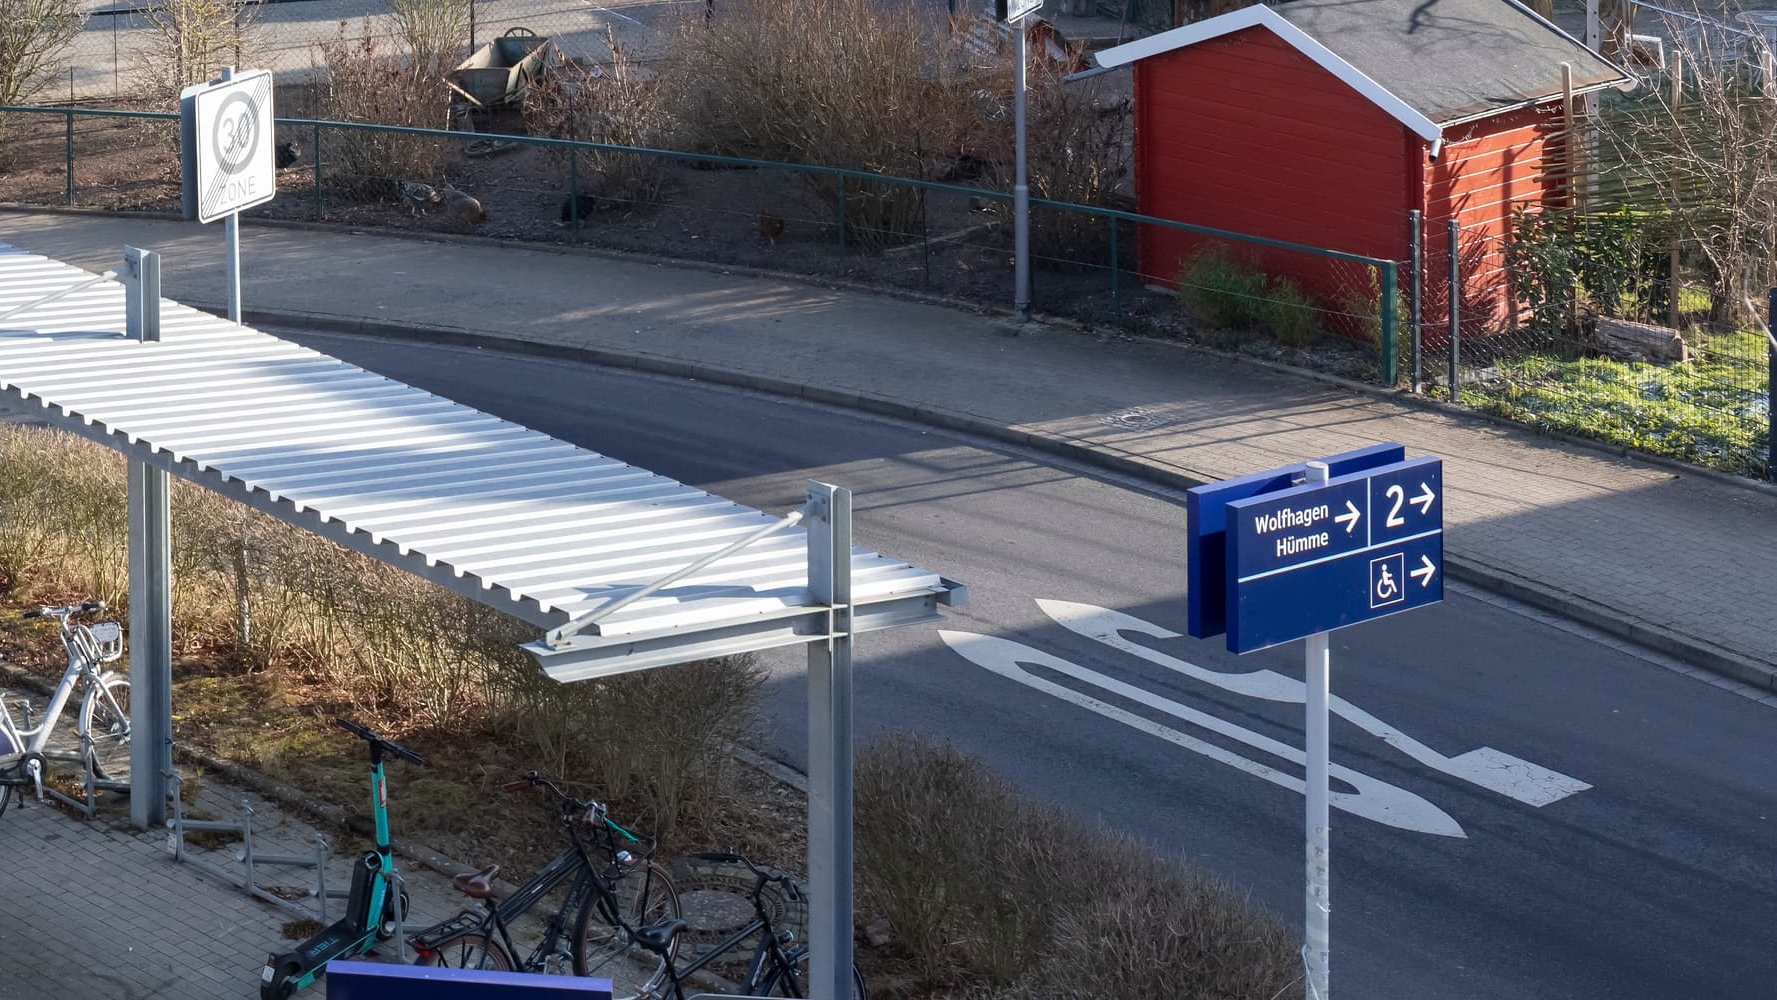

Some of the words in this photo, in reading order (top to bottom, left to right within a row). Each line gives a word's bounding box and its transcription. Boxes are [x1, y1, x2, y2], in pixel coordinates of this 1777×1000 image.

[222, 112, 251, 155] 30
[220, 175, 257, 205] ZONE
[1255, 505, 1328, 534] Wolfhagen
[1386, 485, 1405, 528] 2
[1277, 531, 1328, 557] Hümme
